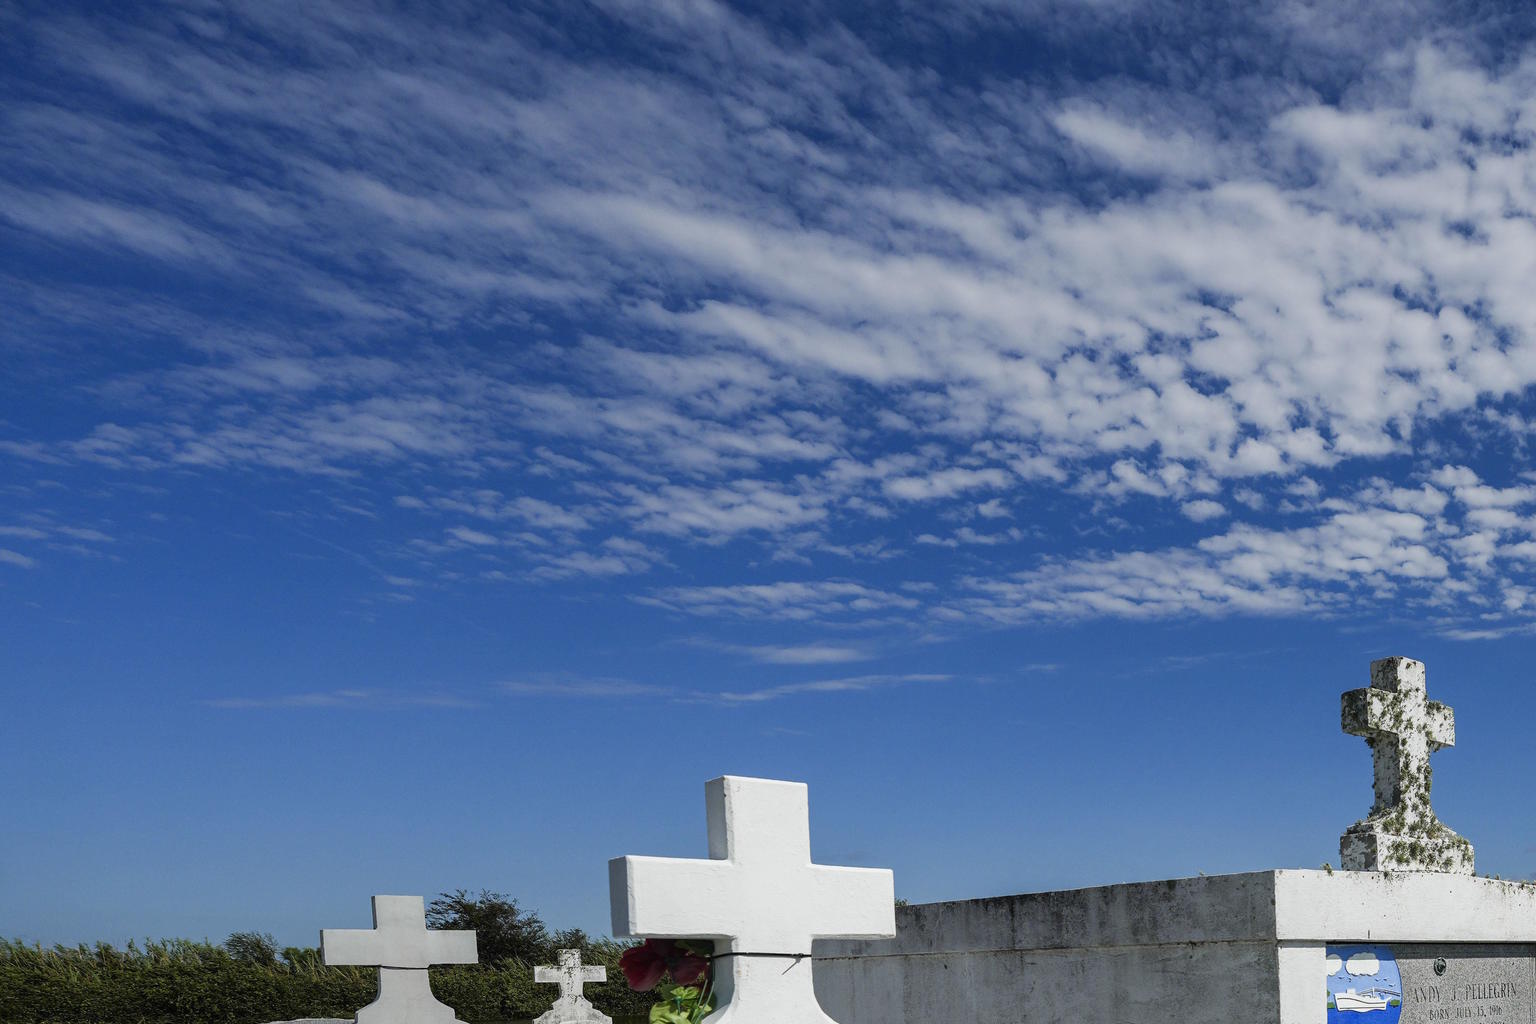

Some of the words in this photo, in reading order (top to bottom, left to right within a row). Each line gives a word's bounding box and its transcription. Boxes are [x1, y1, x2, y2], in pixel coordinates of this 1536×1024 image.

[1412, 985, 1441, 1003] ANDY
[1465, 982, 1517, 1001] PELLEGRIN
[1429, 1008, 1450, 1021] BORN
[1454, 1006, 1472, 1019] JULY
